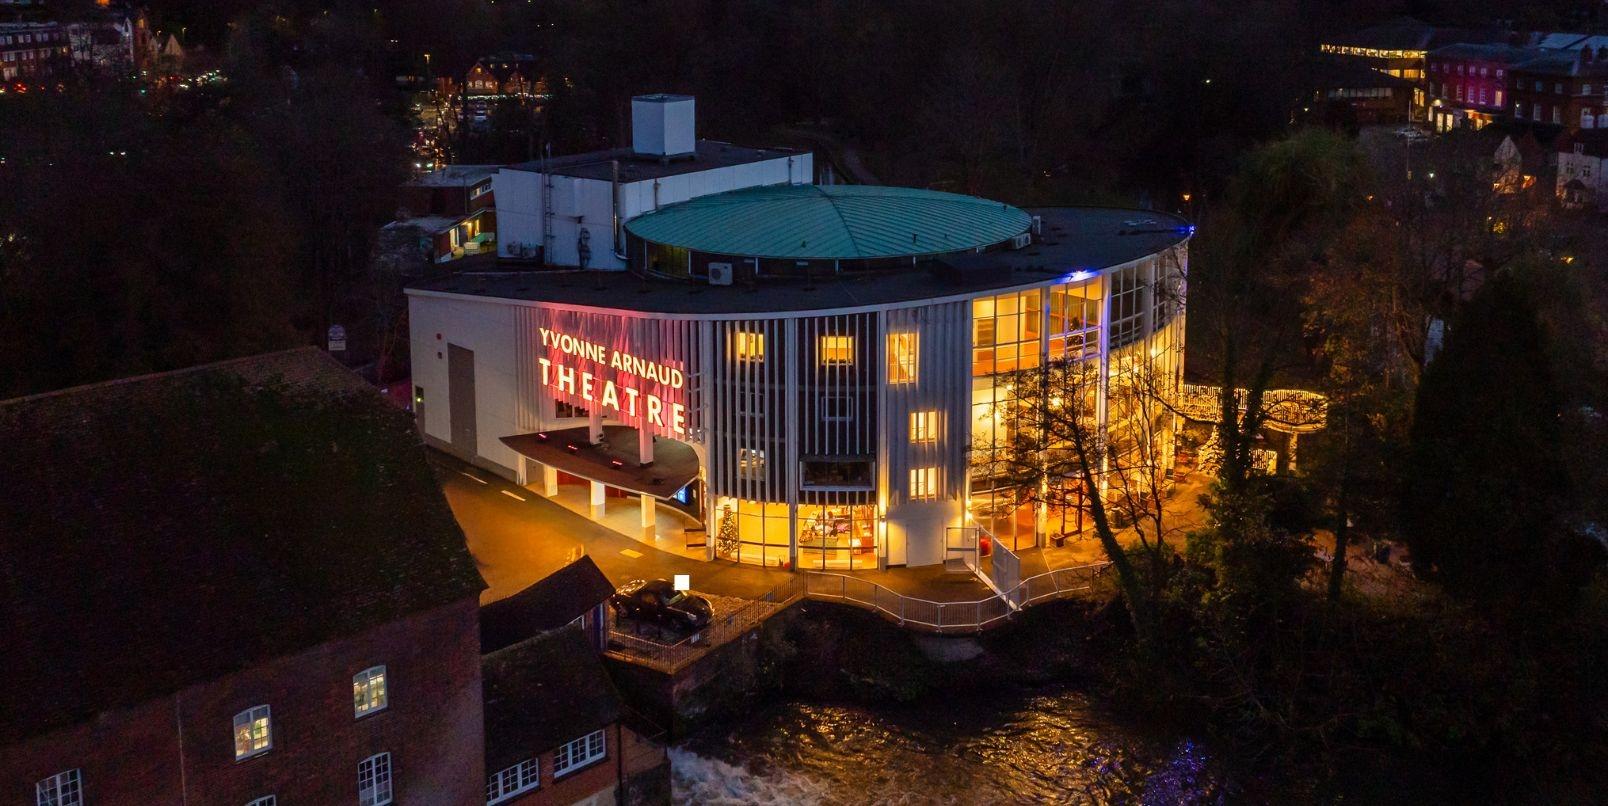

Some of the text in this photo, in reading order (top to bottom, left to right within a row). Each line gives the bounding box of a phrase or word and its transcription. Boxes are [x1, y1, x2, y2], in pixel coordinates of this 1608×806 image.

[539, 327, 683, 389] YVONNE ARNAUD
[539, 357, 685, 434] THEATRE
